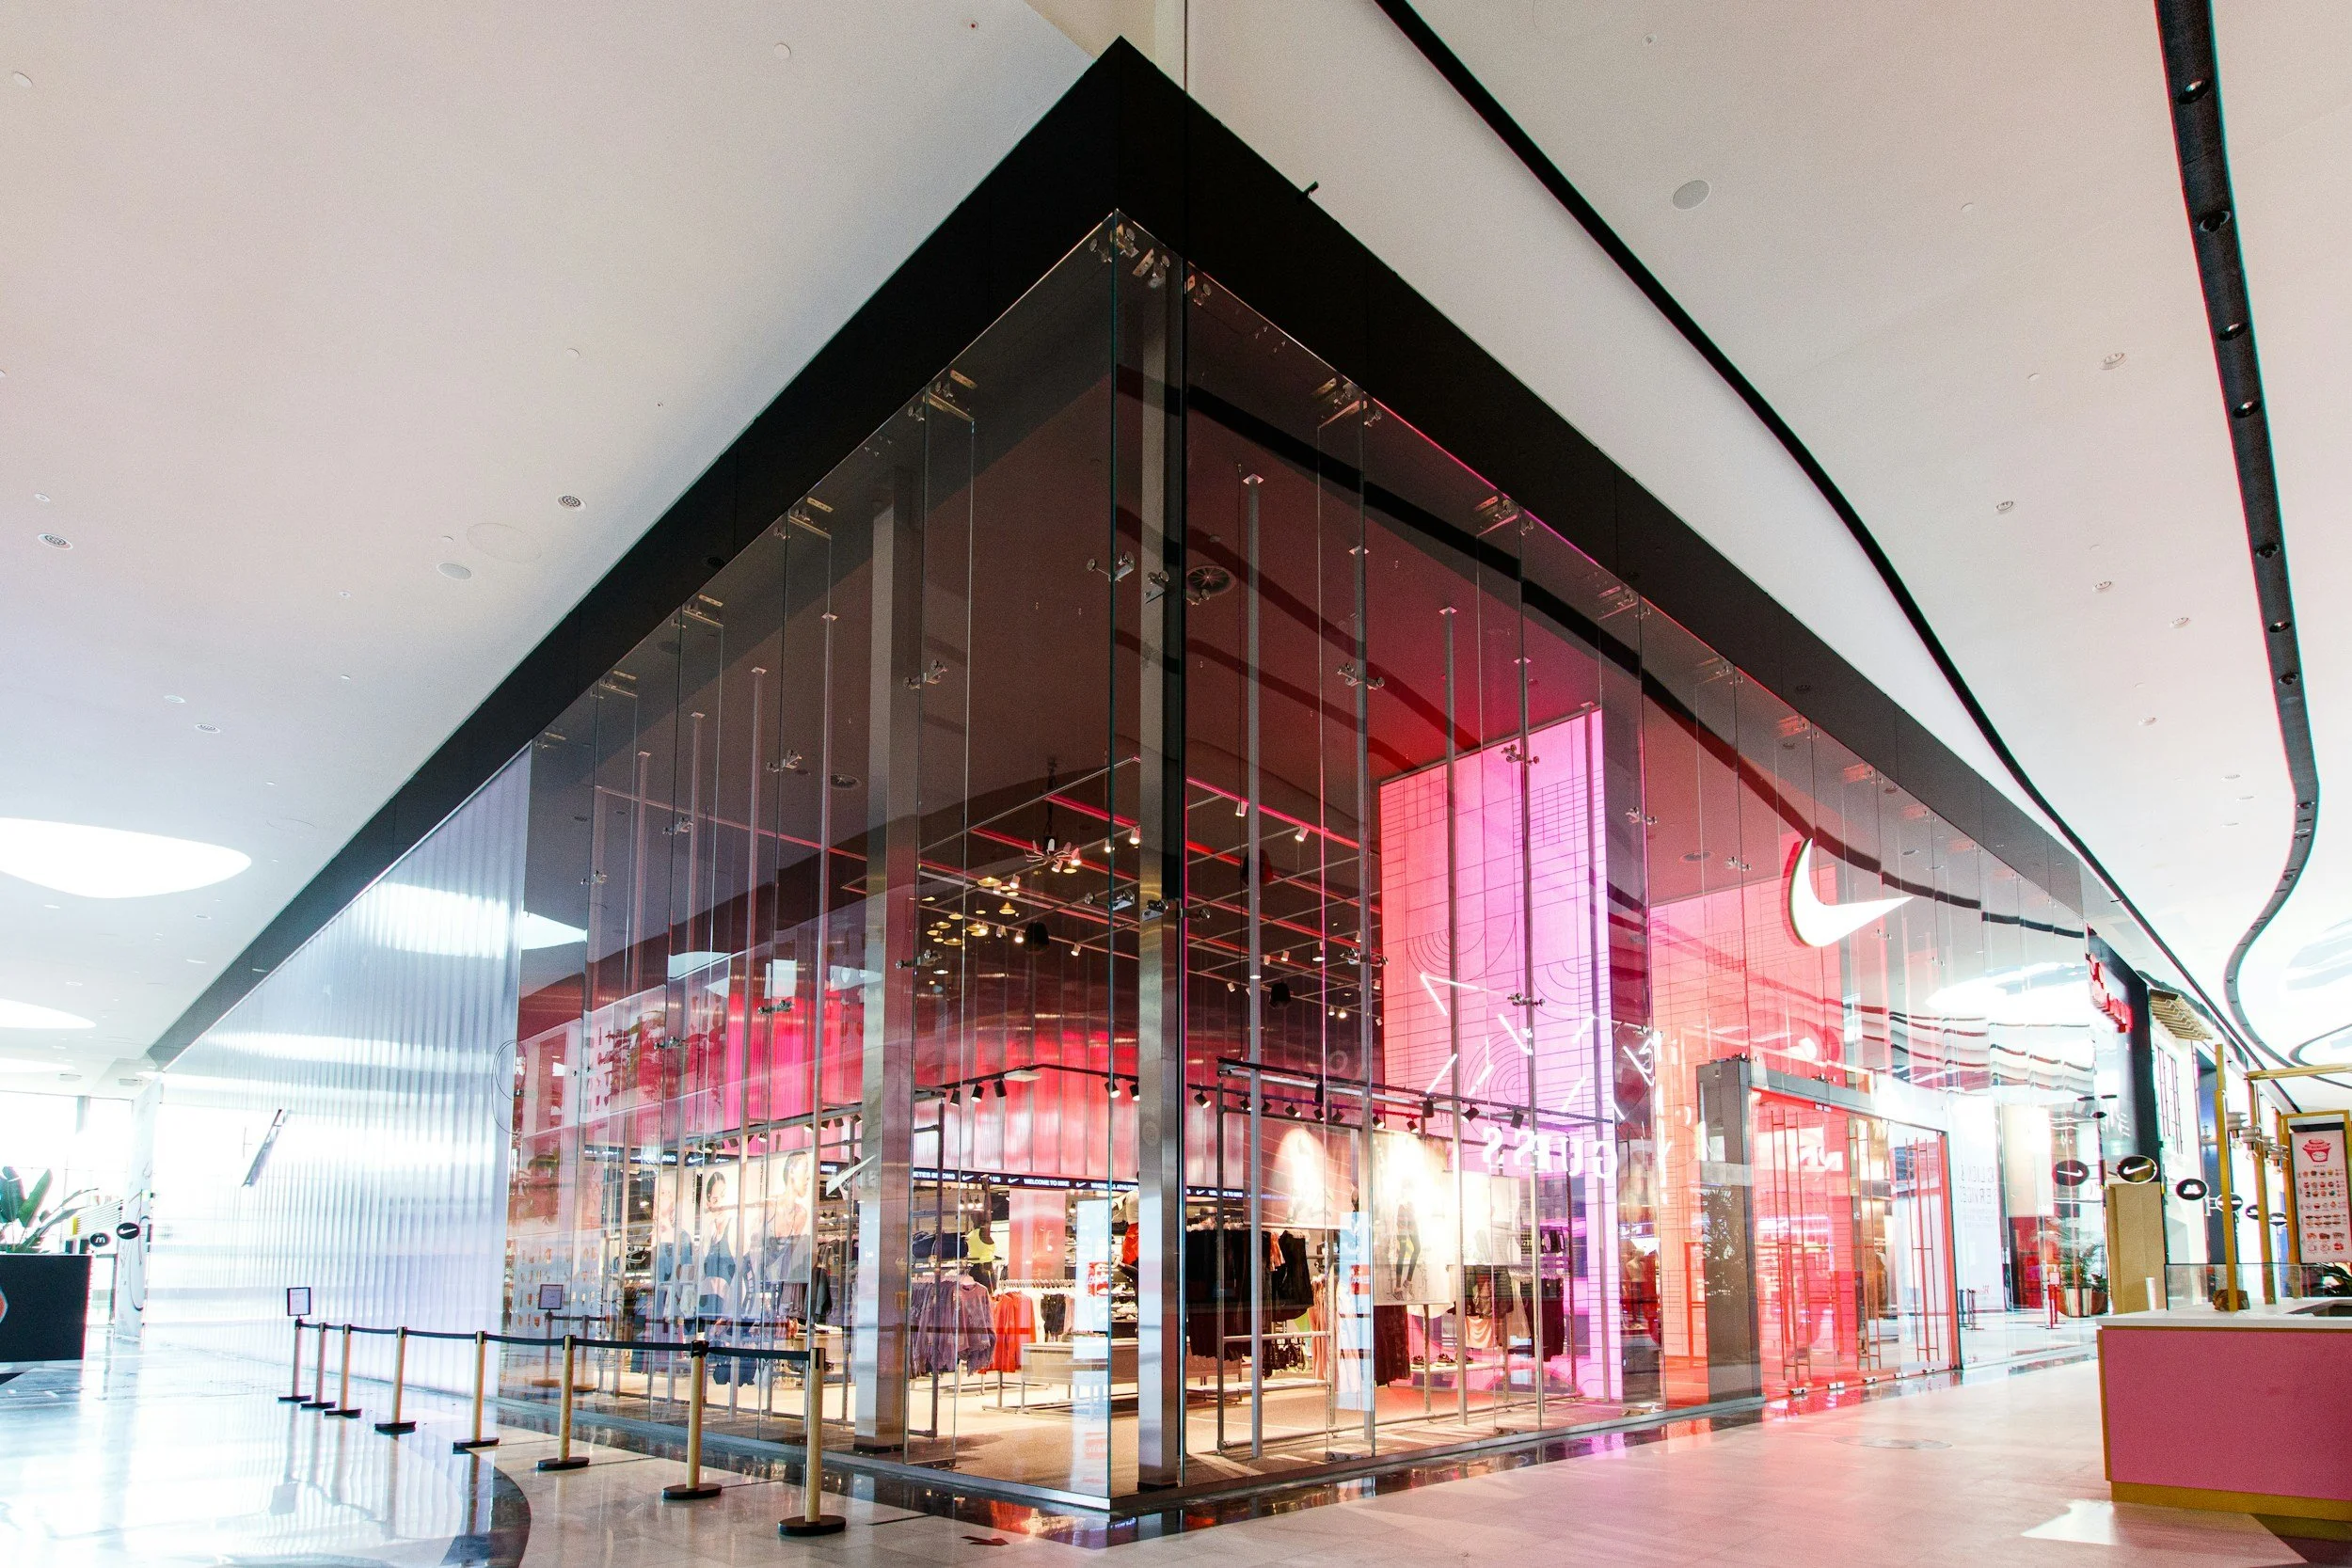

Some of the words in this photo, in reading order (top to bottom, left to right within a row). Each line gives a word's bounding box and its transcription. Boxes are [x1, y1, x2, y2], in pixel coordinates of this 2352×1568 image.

[820, 1164, 837, 1173] NIKE
[931, 1172, 956, 1180] BEONG
[1024, 1178, 1050, 1186] WELCOME
